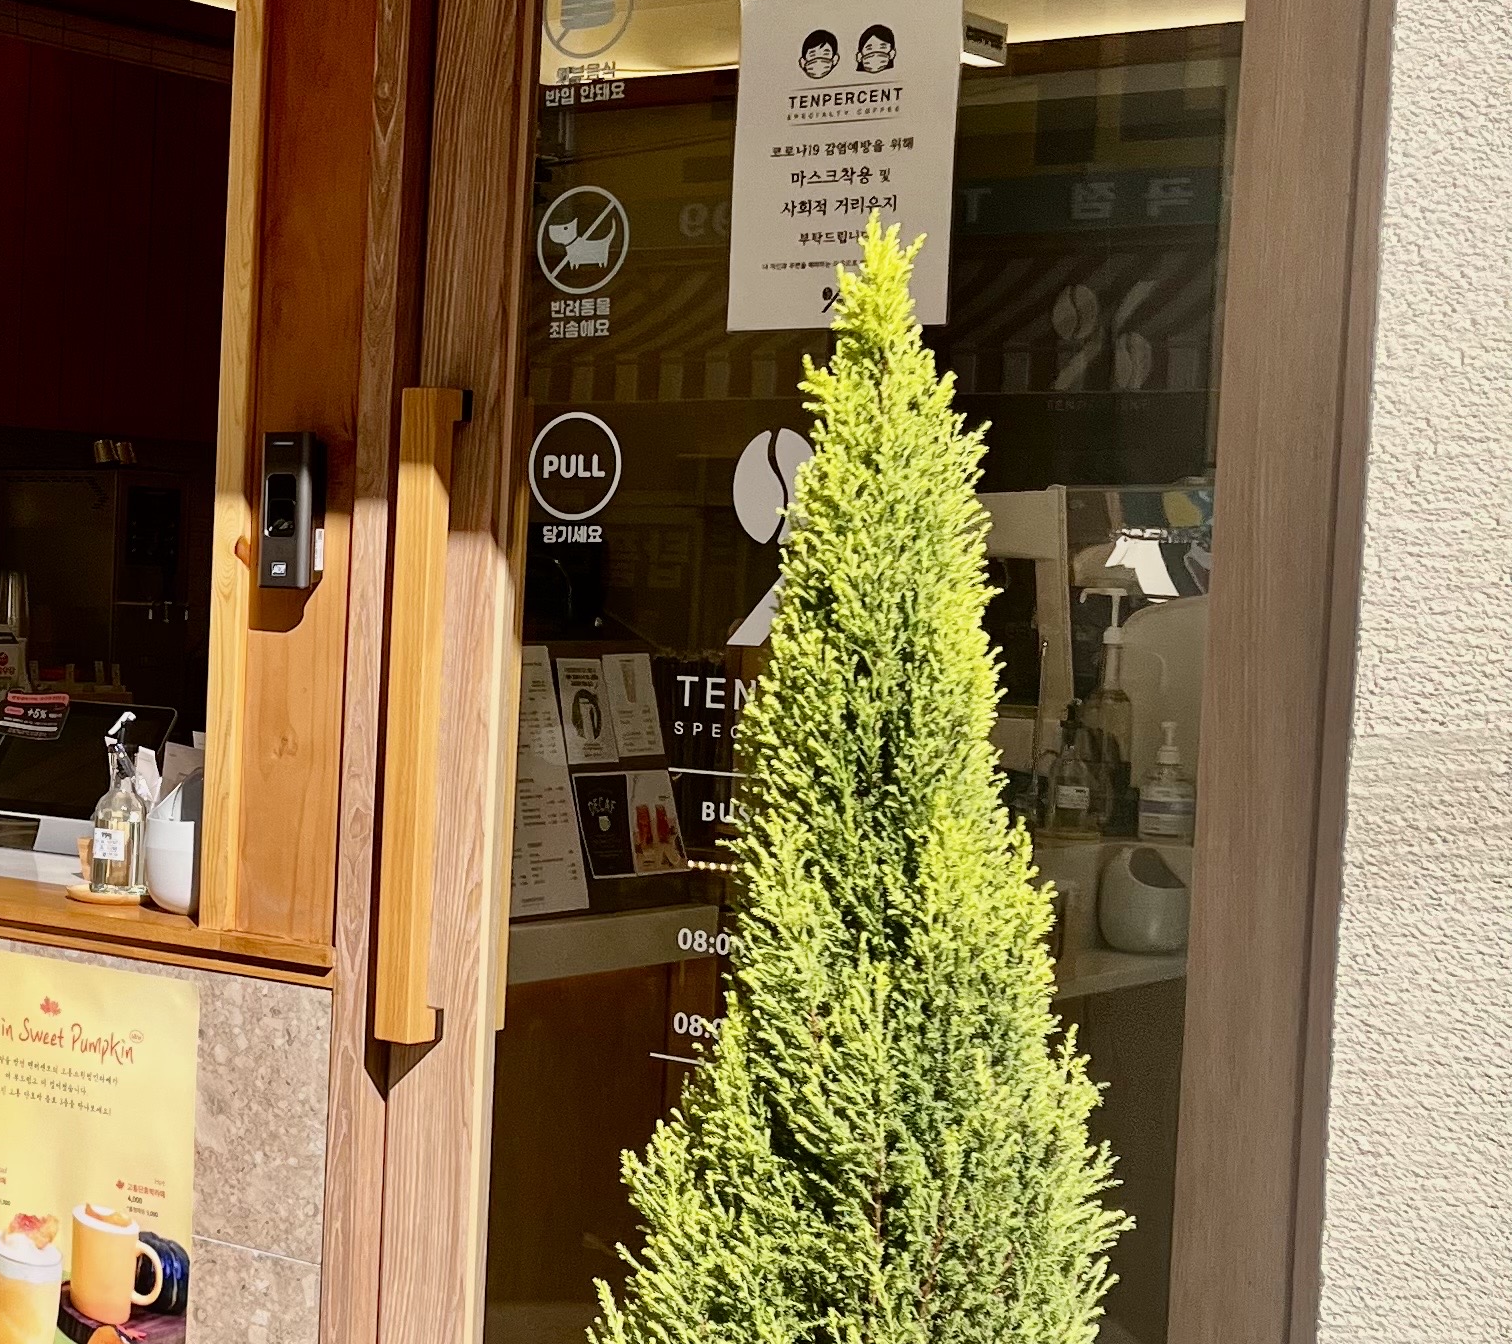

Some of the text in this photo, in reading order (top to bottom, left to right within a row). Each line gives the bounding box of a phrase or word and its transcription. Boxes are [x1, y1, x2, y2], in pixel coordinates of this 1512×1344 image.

[545, 86, 575, 107] 반입
[788, 87, 904, 110] TENPERCENT
[770, 136, 915, 158] 코로나19 감염예방을 위해
[791, 166, 892, 188] 마스크착용 및
[780, 194, 898, 218] 사회적 거리유지
[551, 297, 611, 318] 반려동물
[542, 453, 606, 479] PULL
[542, 525, 603, 543] 당기세요
[1, 1018, 14, 1042] in
[18, 1017, 65, 1048] Sweet
[71, 1023, 135, 1065] Pumpkin
